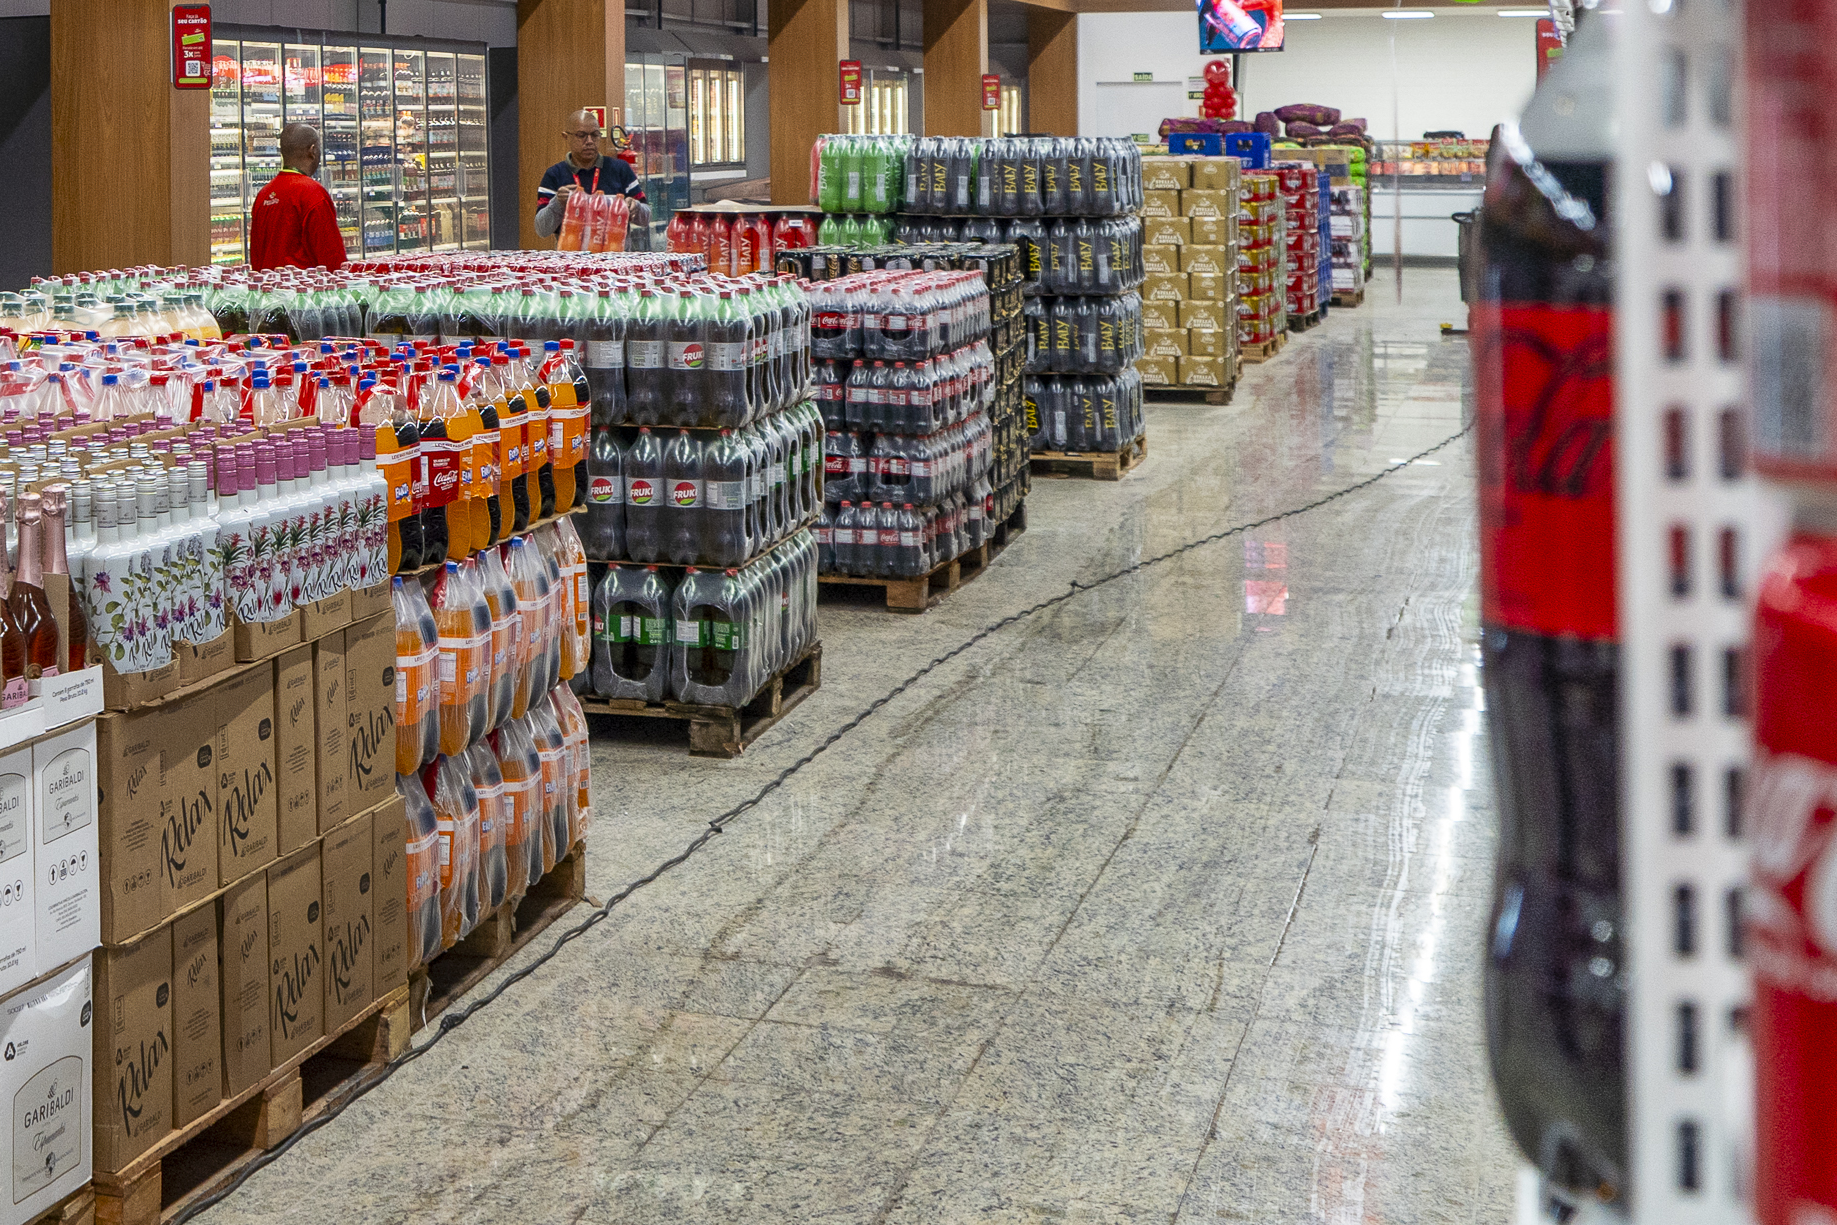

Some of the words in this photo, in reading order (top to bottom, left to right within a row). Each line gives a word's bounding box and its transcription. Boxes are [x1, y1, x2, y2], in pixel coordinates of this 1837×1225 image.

[934, 163, 946, 193] BALY
[1005, 164, 1017, 194] BALY
[1024, 164, 1037, 194] BALY
[1069, 163, 1081, 192] BALY
[1095, 163, 1107, 192] BALY
[593, 216, 605, 244] BALY
[719, 238, 729, 266] BALY
[740, 236, 751, 266] BALY
[1029, 243, 1041, 272] BALY
[1081, 242, 1093, 271] BALY
[1057, 320, 1070, 349] BALY
[1101, 321, 1115, 350] BALY
[1104, 399, 1117, 429] BALY
[631, 486, 654, 498] FRUKI
[674, 488, 697, 500] FRUKI
[349, 703, 394, 791] Relax
[49, 770, 85, 795] GARIBALDI
[223, 758, 273, 858] Relax
[160, 786, 213, 889] Relax
[328, 914, 371, 1006] Relax
[274, 944, 320, 1040] Relax
[118, 1030, 169, 1138] Relax
[24, 1086, 75, 1130] GARIBALDI
